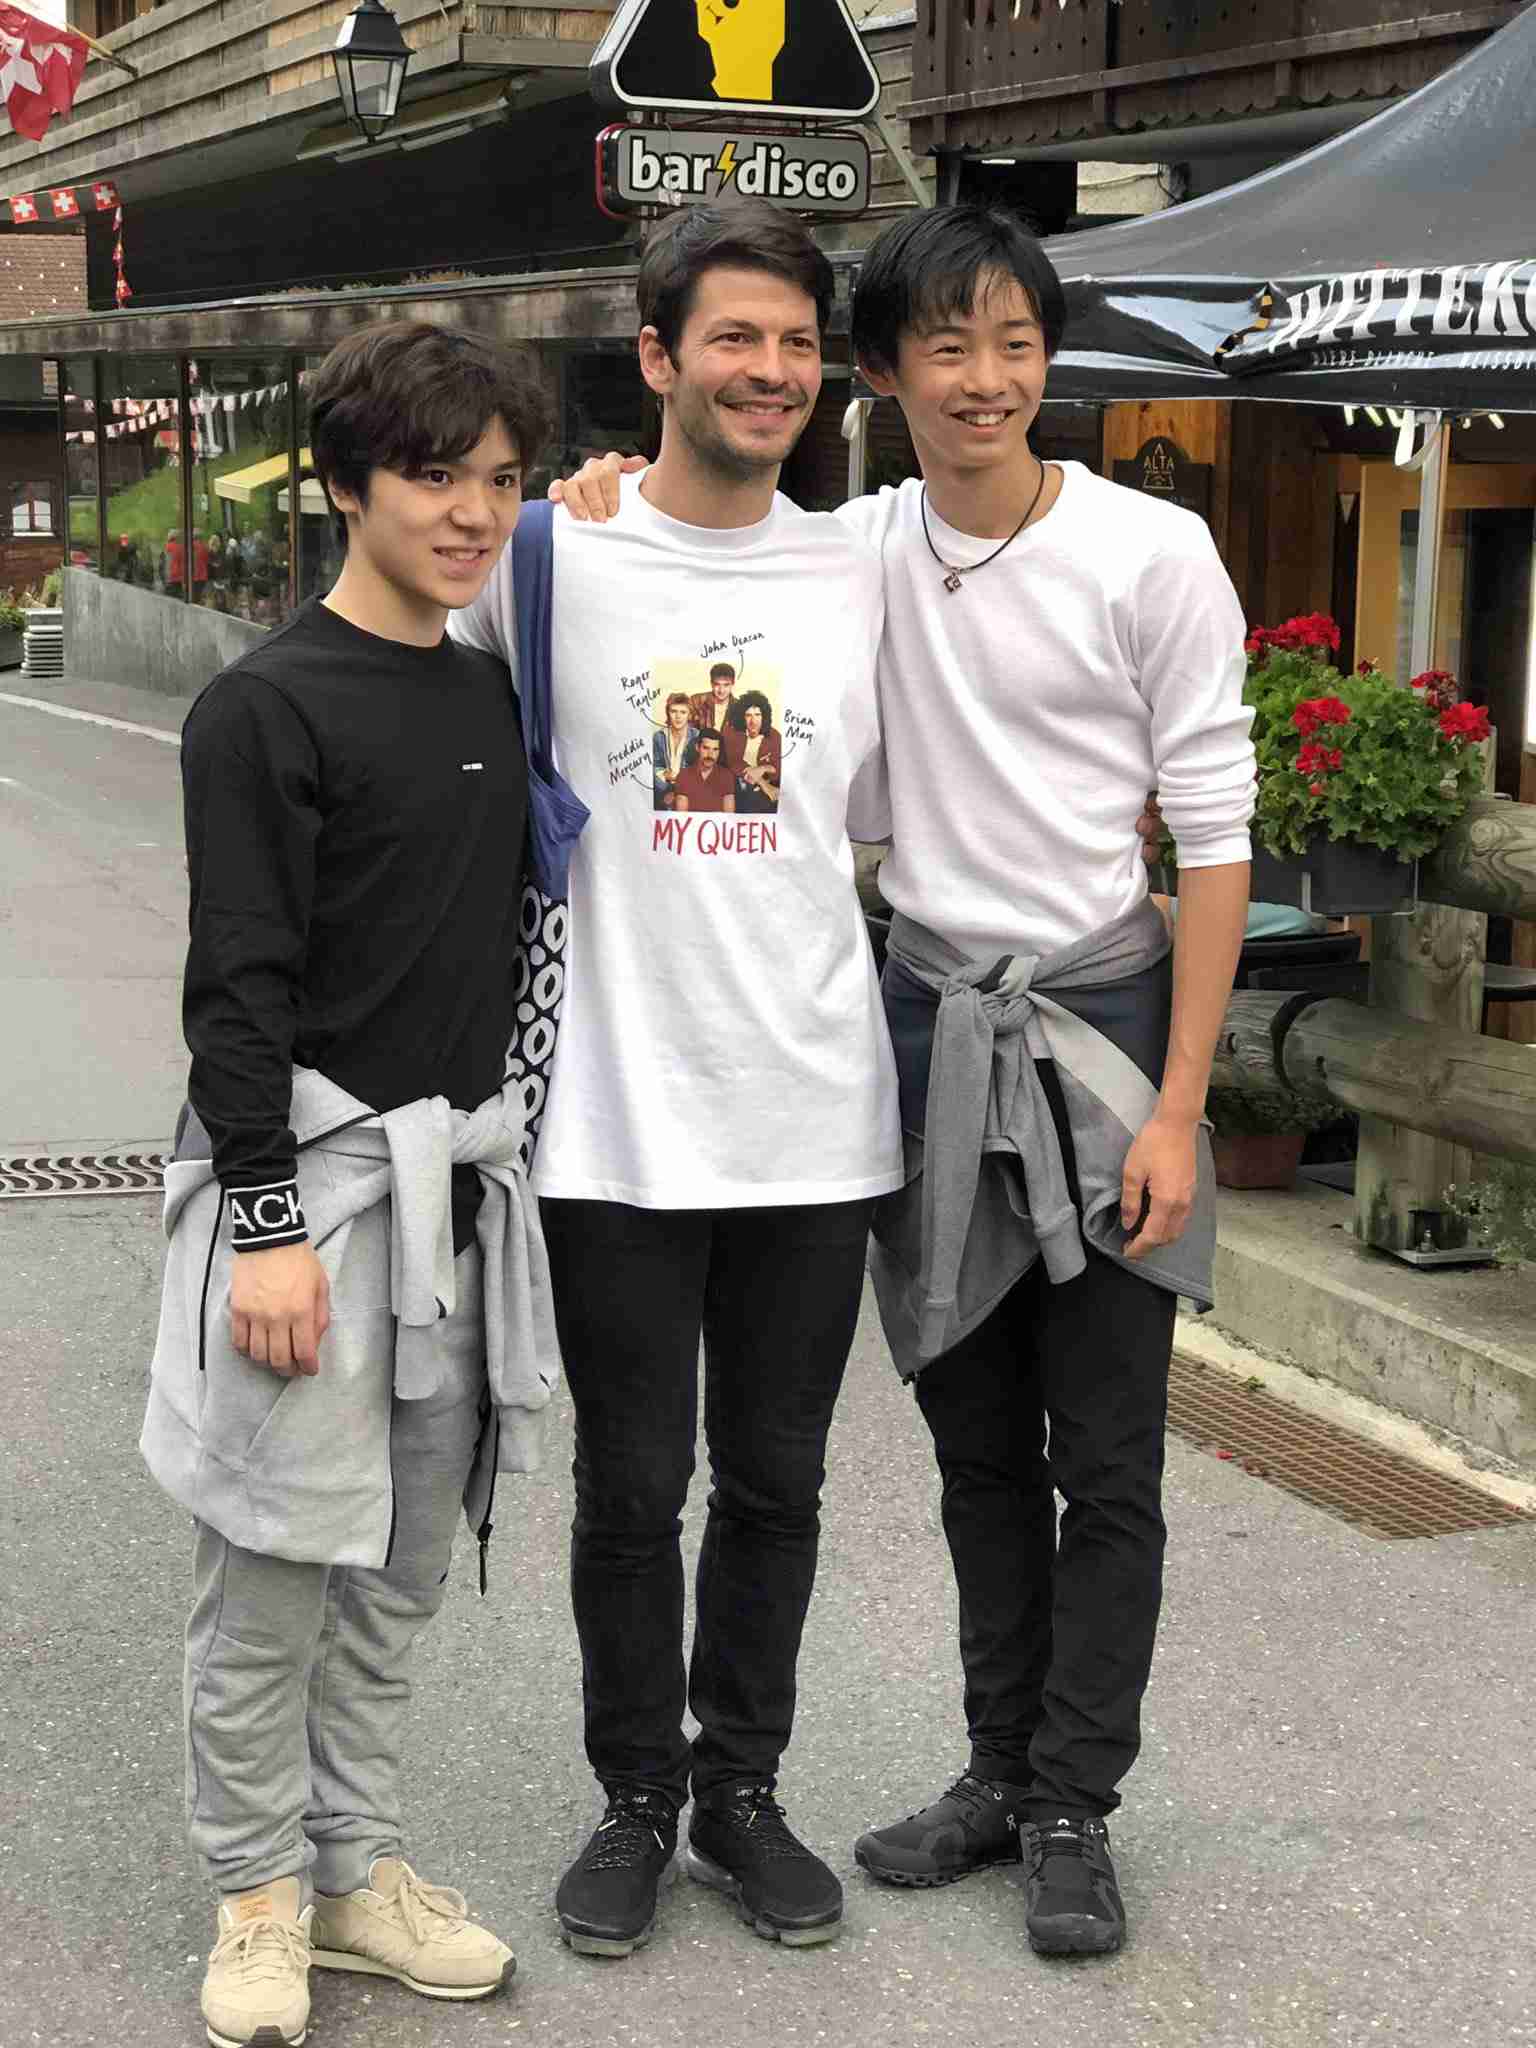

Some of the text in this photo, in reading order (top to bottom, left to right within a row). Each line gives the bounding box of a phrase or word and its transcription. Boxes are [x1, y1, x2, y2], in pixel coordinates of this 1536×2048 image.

[630, 137, 857, 199] bar disco
[1265, 260, 1536, 353] WITTEK
[1143, 455, 1175, 470] ALTA
[699, 630, 765, 658] John Deacon
[620, 670, 651, 690] Roger
[626, 688, 663, 710] Taylor
[784, 709, 815, 726] Brian
[785, 726, 814, 744] May
[607, 737, 645, 764] Freddie
[609, 751, 652, 785] Mercury
[653, 817, 777, 855] MY QUEEN
